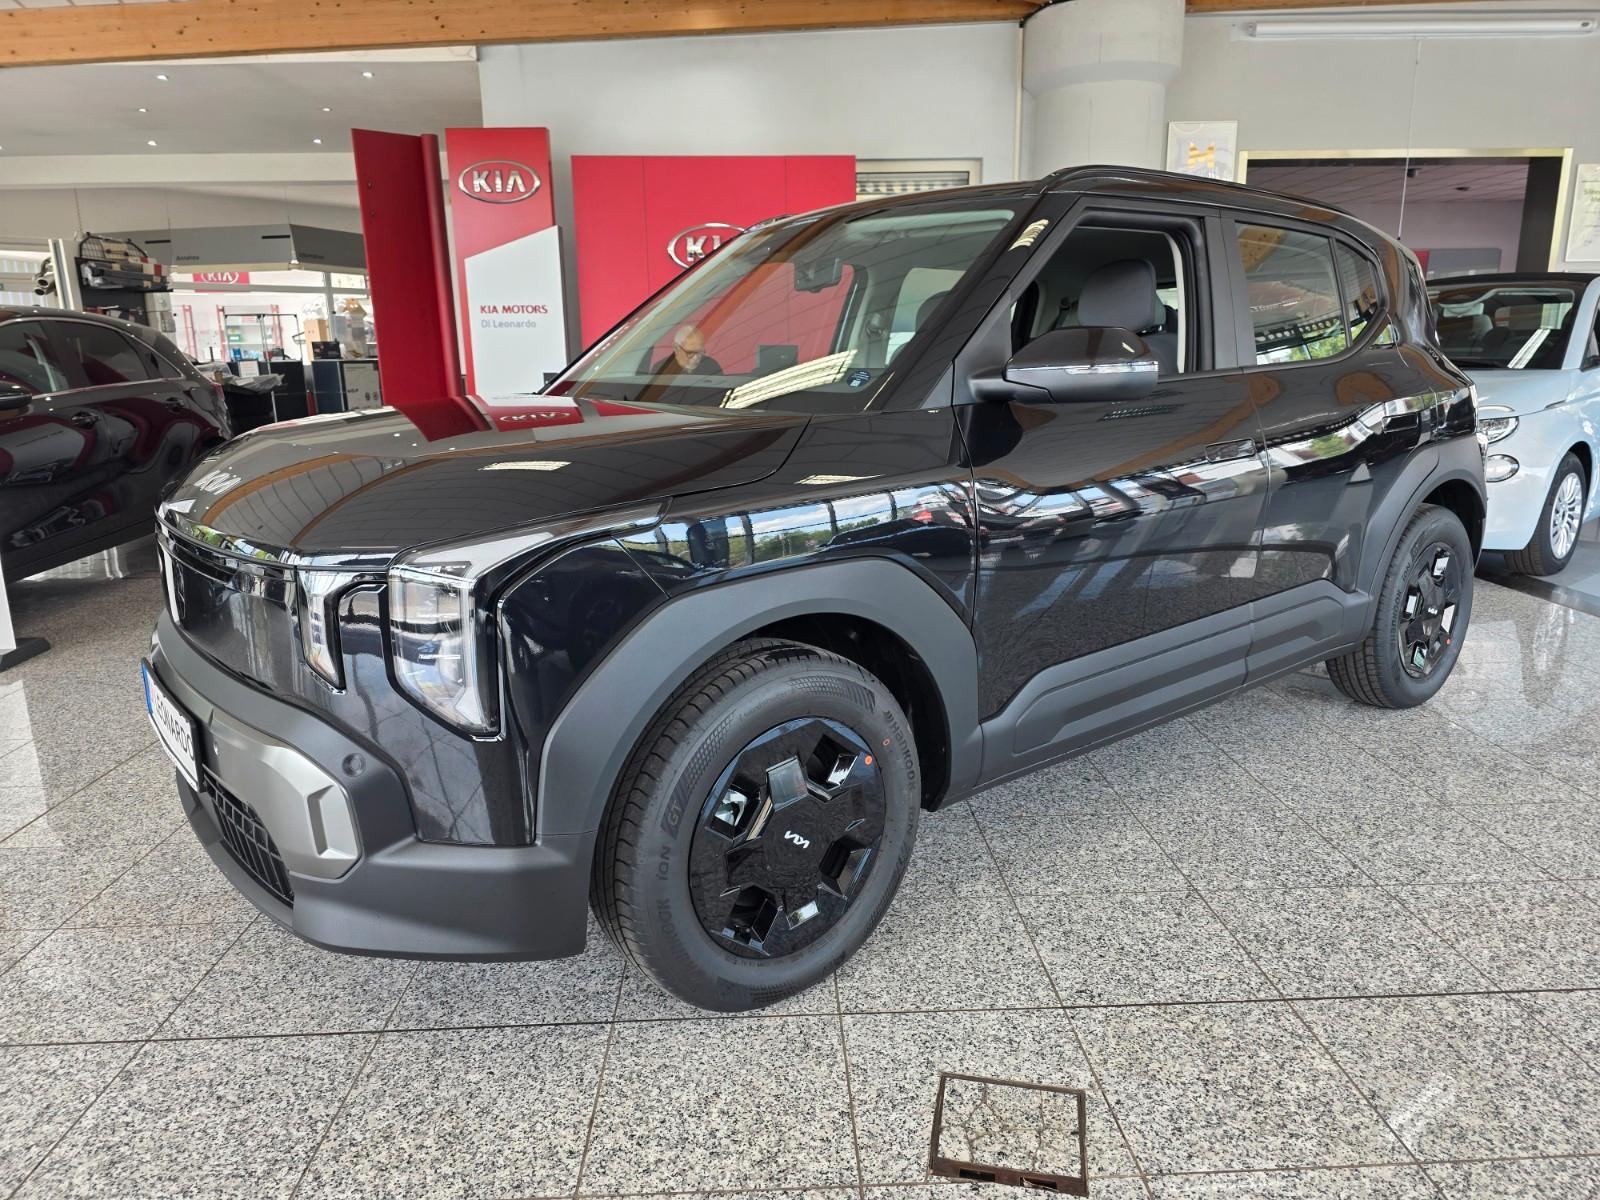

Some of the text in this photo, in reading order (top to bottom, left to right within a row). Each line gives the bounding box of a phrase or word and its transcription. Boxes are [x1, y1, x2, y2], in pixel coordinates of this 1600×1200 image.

[472, 170, 526, 193] KIA
[686, 235, 721, 262] KI
[206, 271, 234, 282] KIA
[480, 304, 549, 314] KIA MOTORS
[481, 319, 537, 328] Di Leonardo
[667, 799, 683, 826] GT
